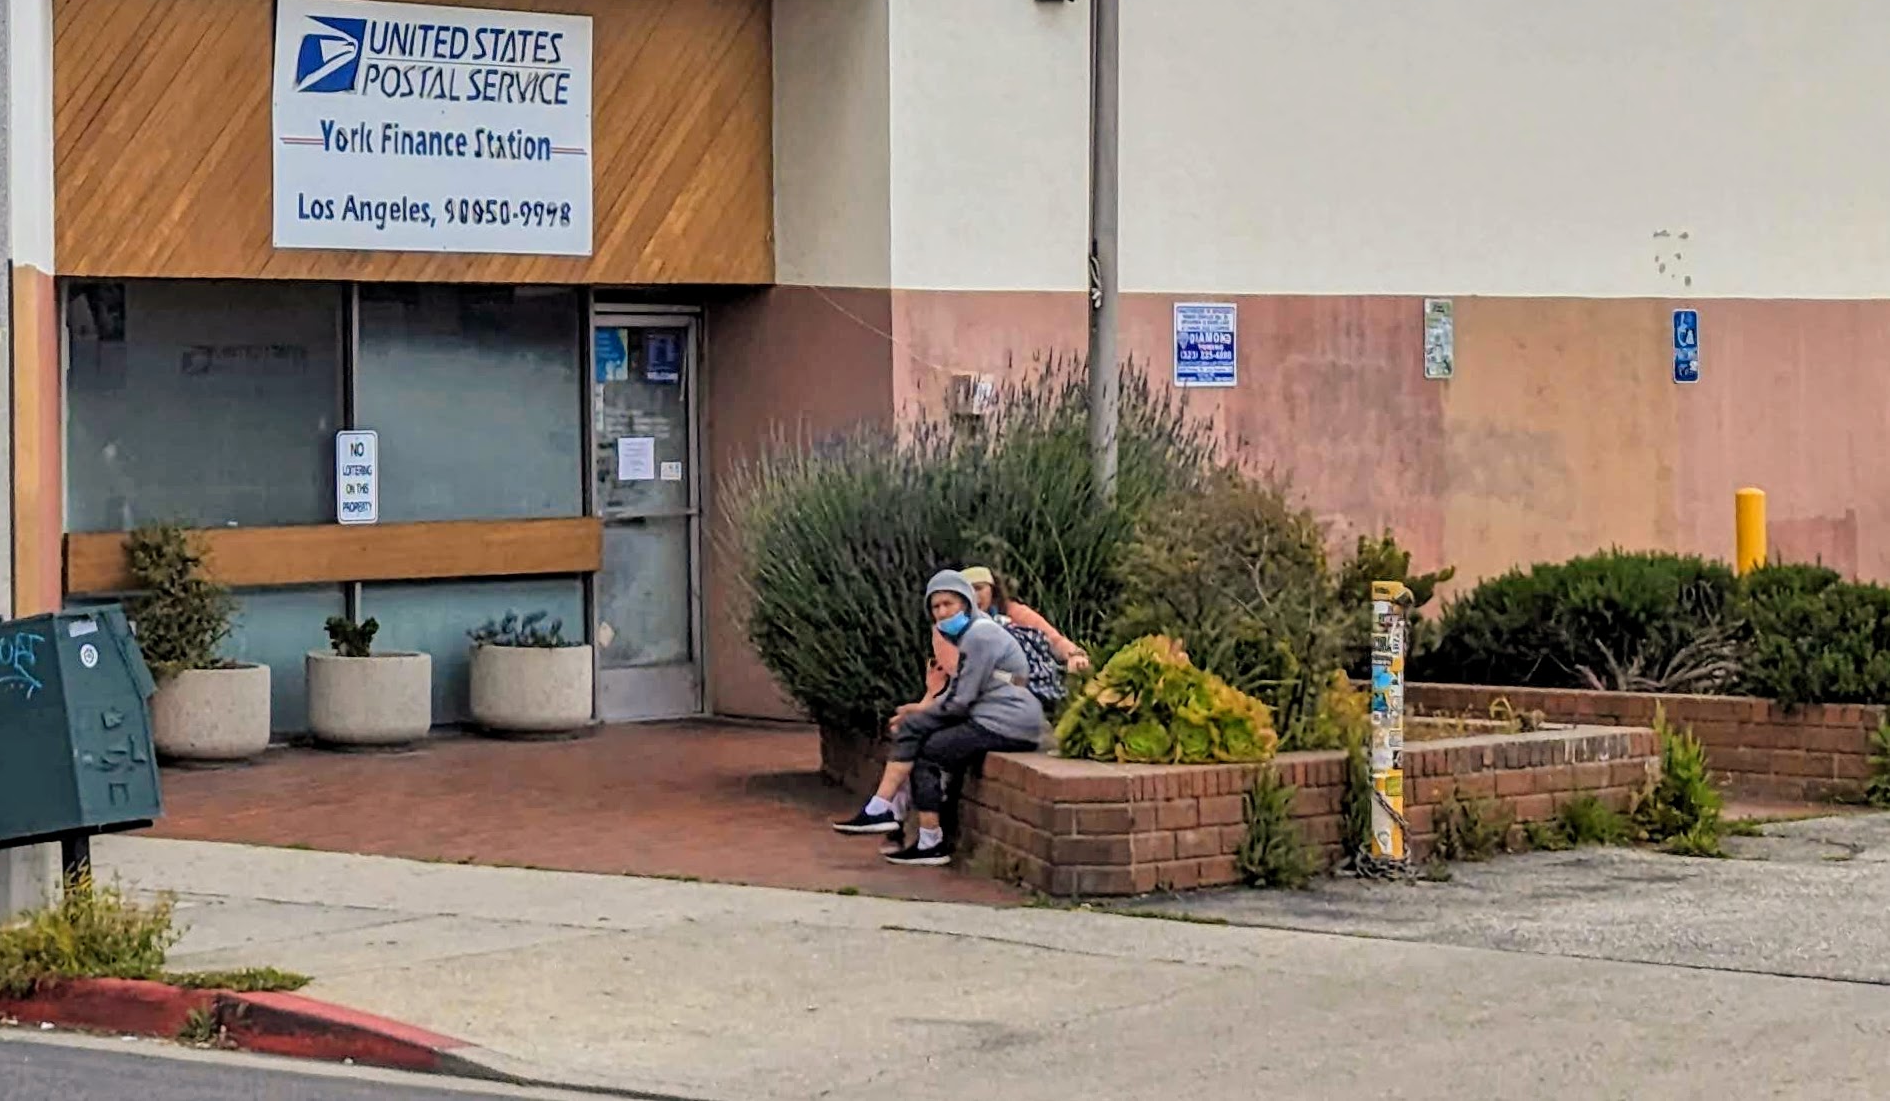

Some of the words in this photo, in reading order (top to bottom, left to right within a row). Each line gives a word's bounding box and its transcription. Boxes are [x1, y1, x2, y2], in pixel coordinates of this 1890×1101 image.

[370, 20, 469, 60] UNITED
[472, 27, 563, 64] STATES
[362, 63, 460, 102] POSTAL
[466, 68, 571, 105] SERVICE
[320, 119, 373, 153] York
[381, 122, 468, 157] Finance
[474, 127, 551, 161] Station
[298, 193, 335, 220] Los
[342, 195, 437, 230] Angeles,
[350, 442, 365, 457] NO
[343, 464, 372, 476] LOITERING
[345, 483, 355, 495] ON
[357, 483, 369, 495] THIS
[343, 501, 372, 513] PROPERTY
